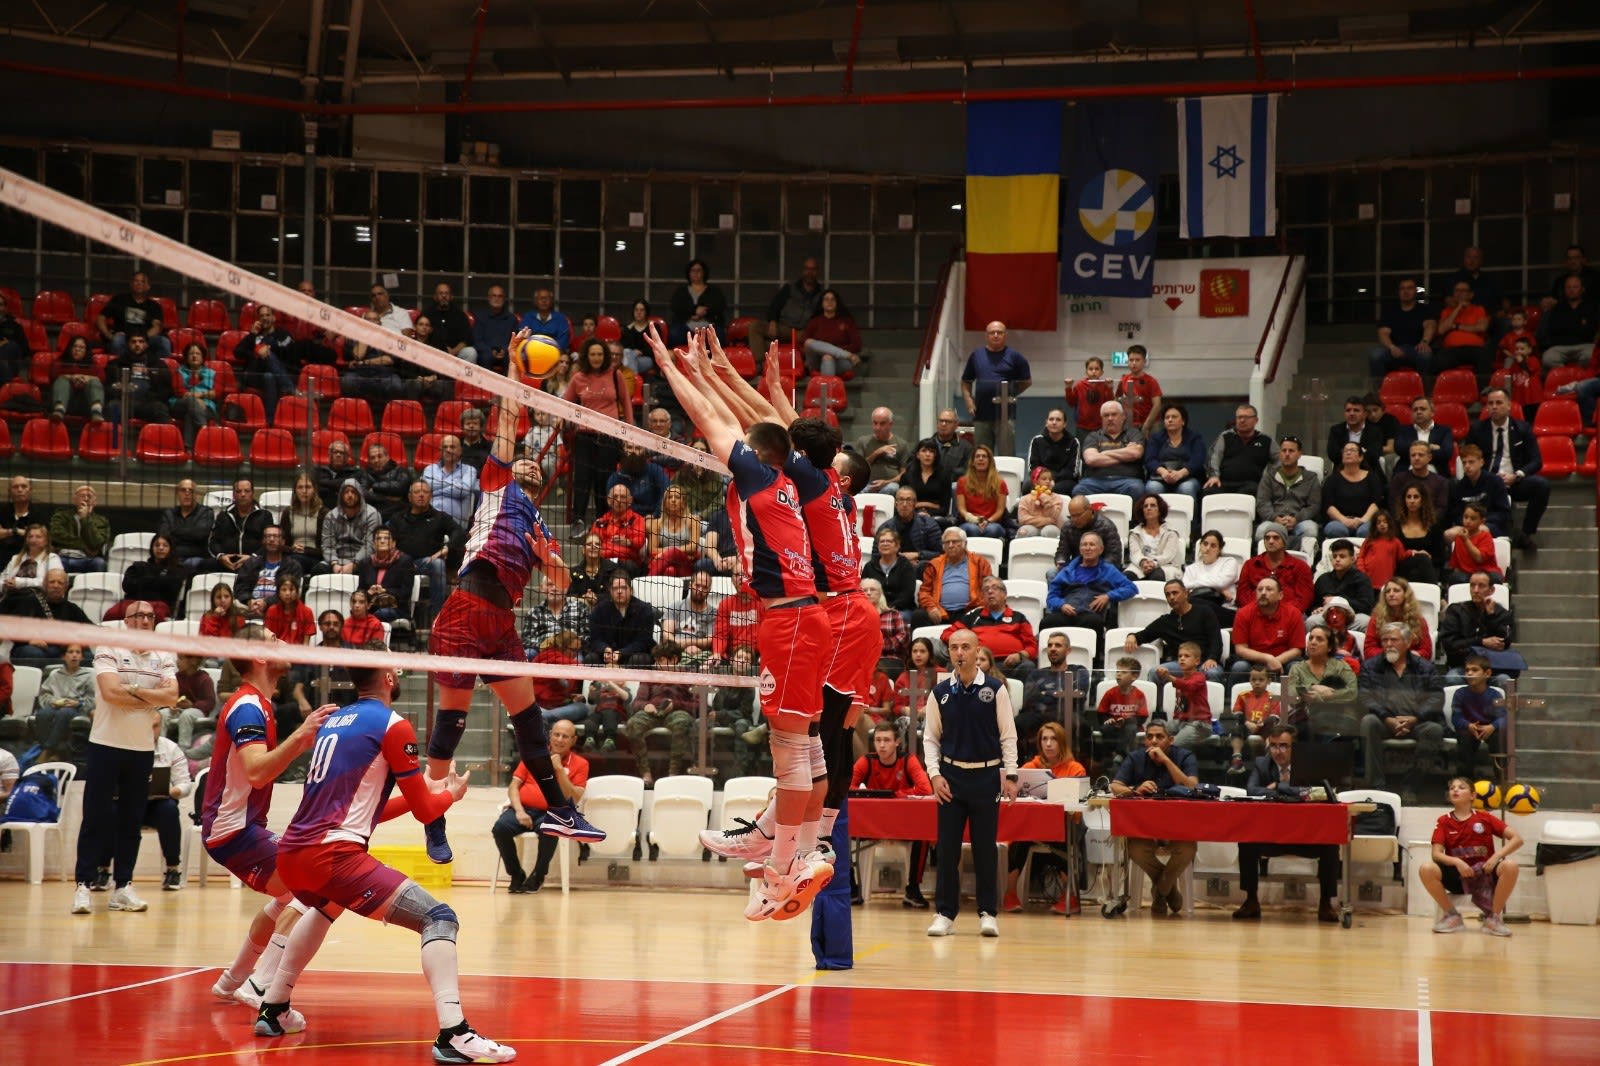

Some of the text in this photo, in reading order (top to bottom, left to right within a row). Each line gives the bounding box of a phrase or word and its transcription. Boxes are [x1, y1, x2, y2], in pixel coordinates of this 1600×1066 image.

[1074, 252, 1151, 280] CEV
[1152, 284, 1195, 294] שרותים
[1070, 301, 1102, 313] חרום
[306, 733, 339, 785] 10
